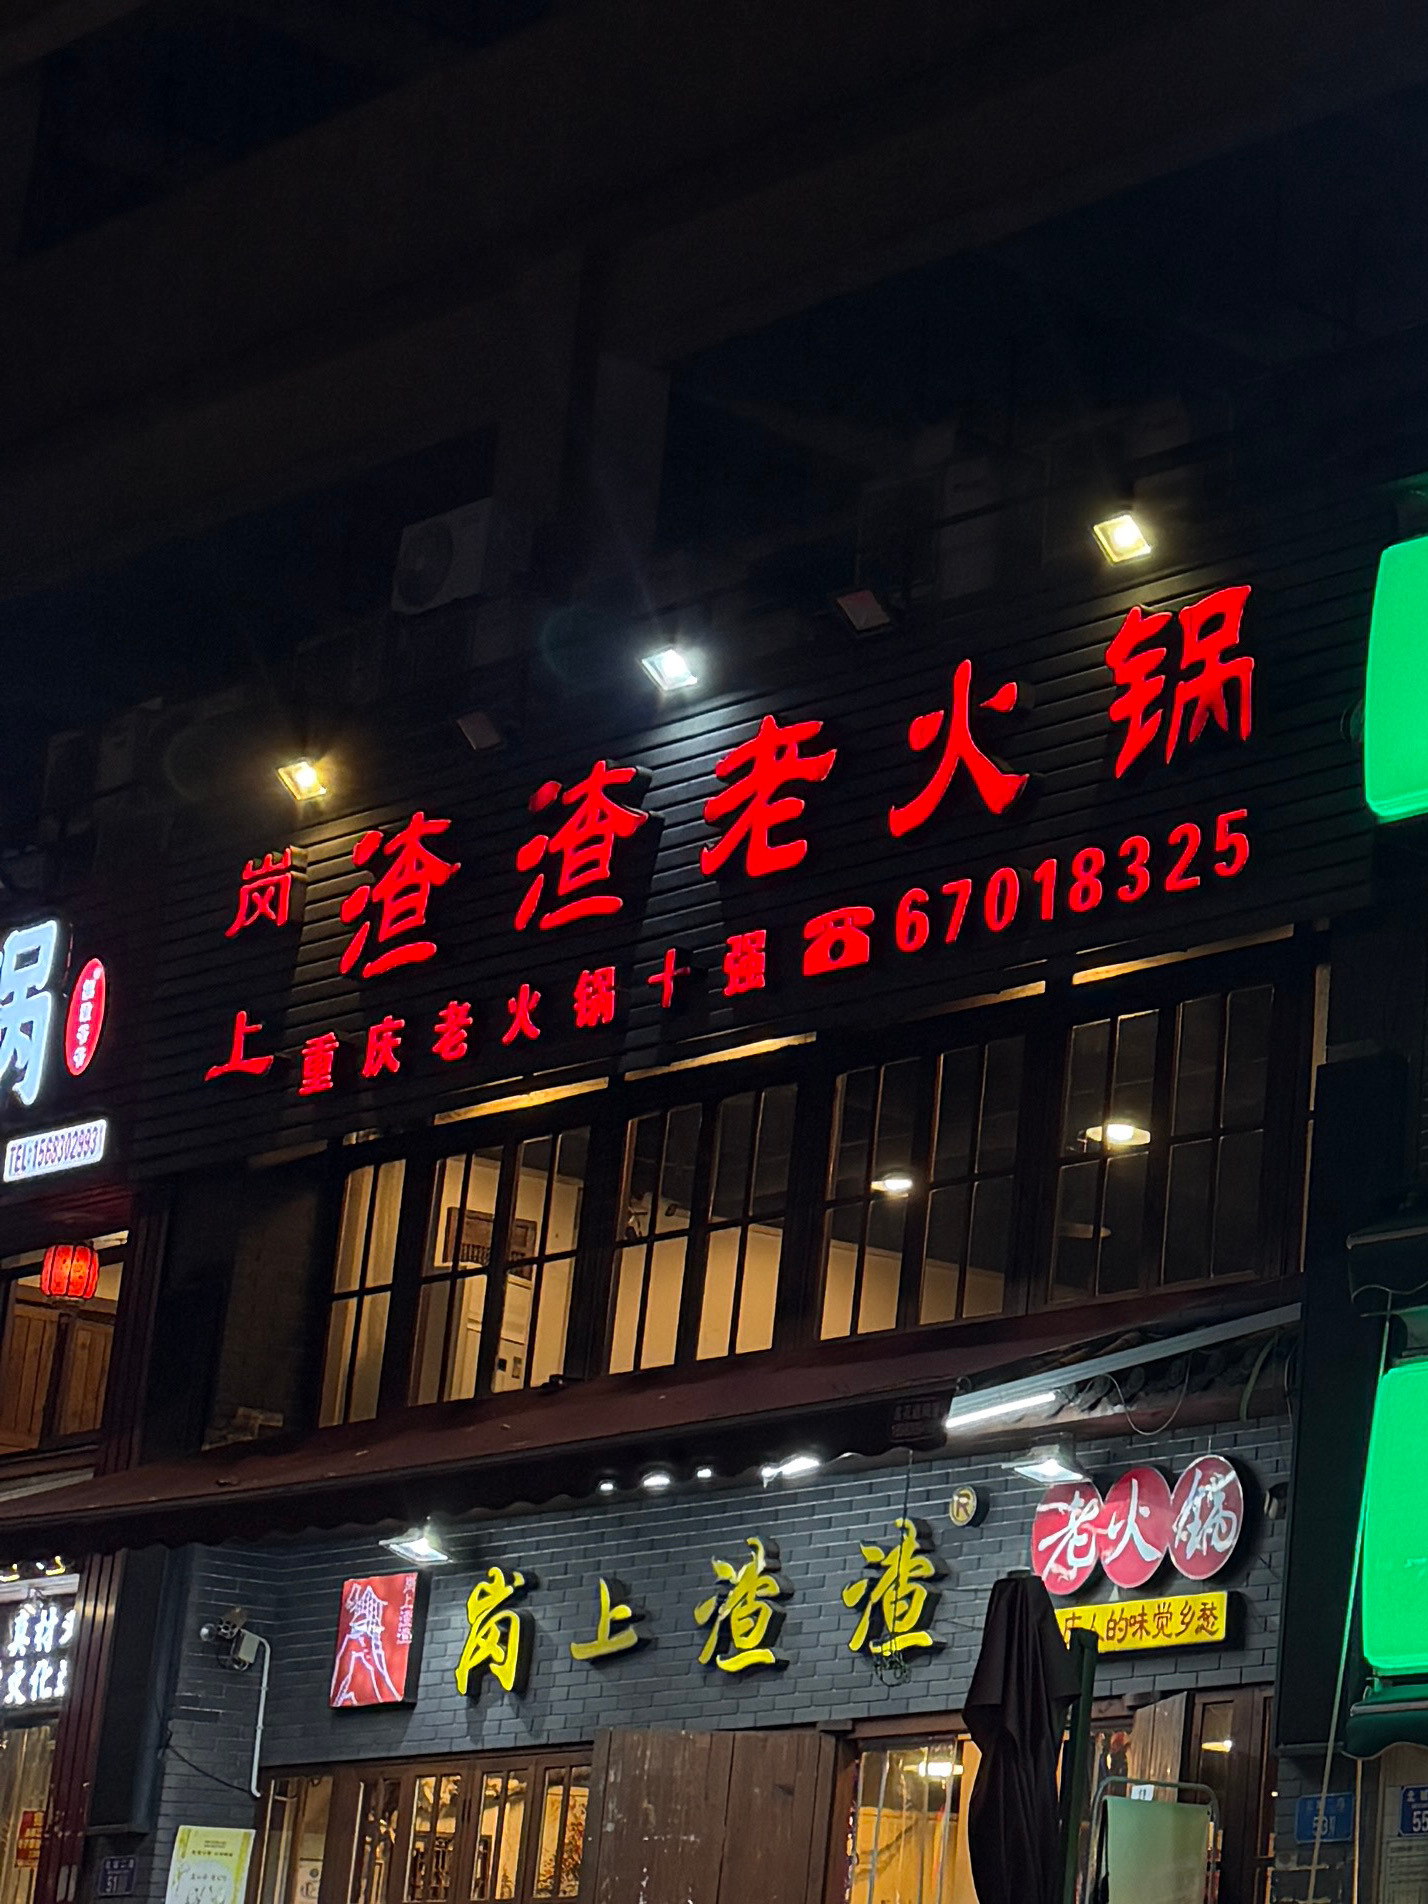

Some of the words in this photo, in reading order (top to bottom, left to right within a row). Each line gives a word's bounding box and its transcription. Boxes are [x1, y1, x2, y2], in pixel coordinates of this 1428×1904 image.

[340, 585, 1255, 978] 渣渣老火锅
[895, 808, 1250, 953] 67018325
[298, 929, 767, 1095] 重庆老火锅十强
[456, 1519, 934, 1694] 岗上渣渣
